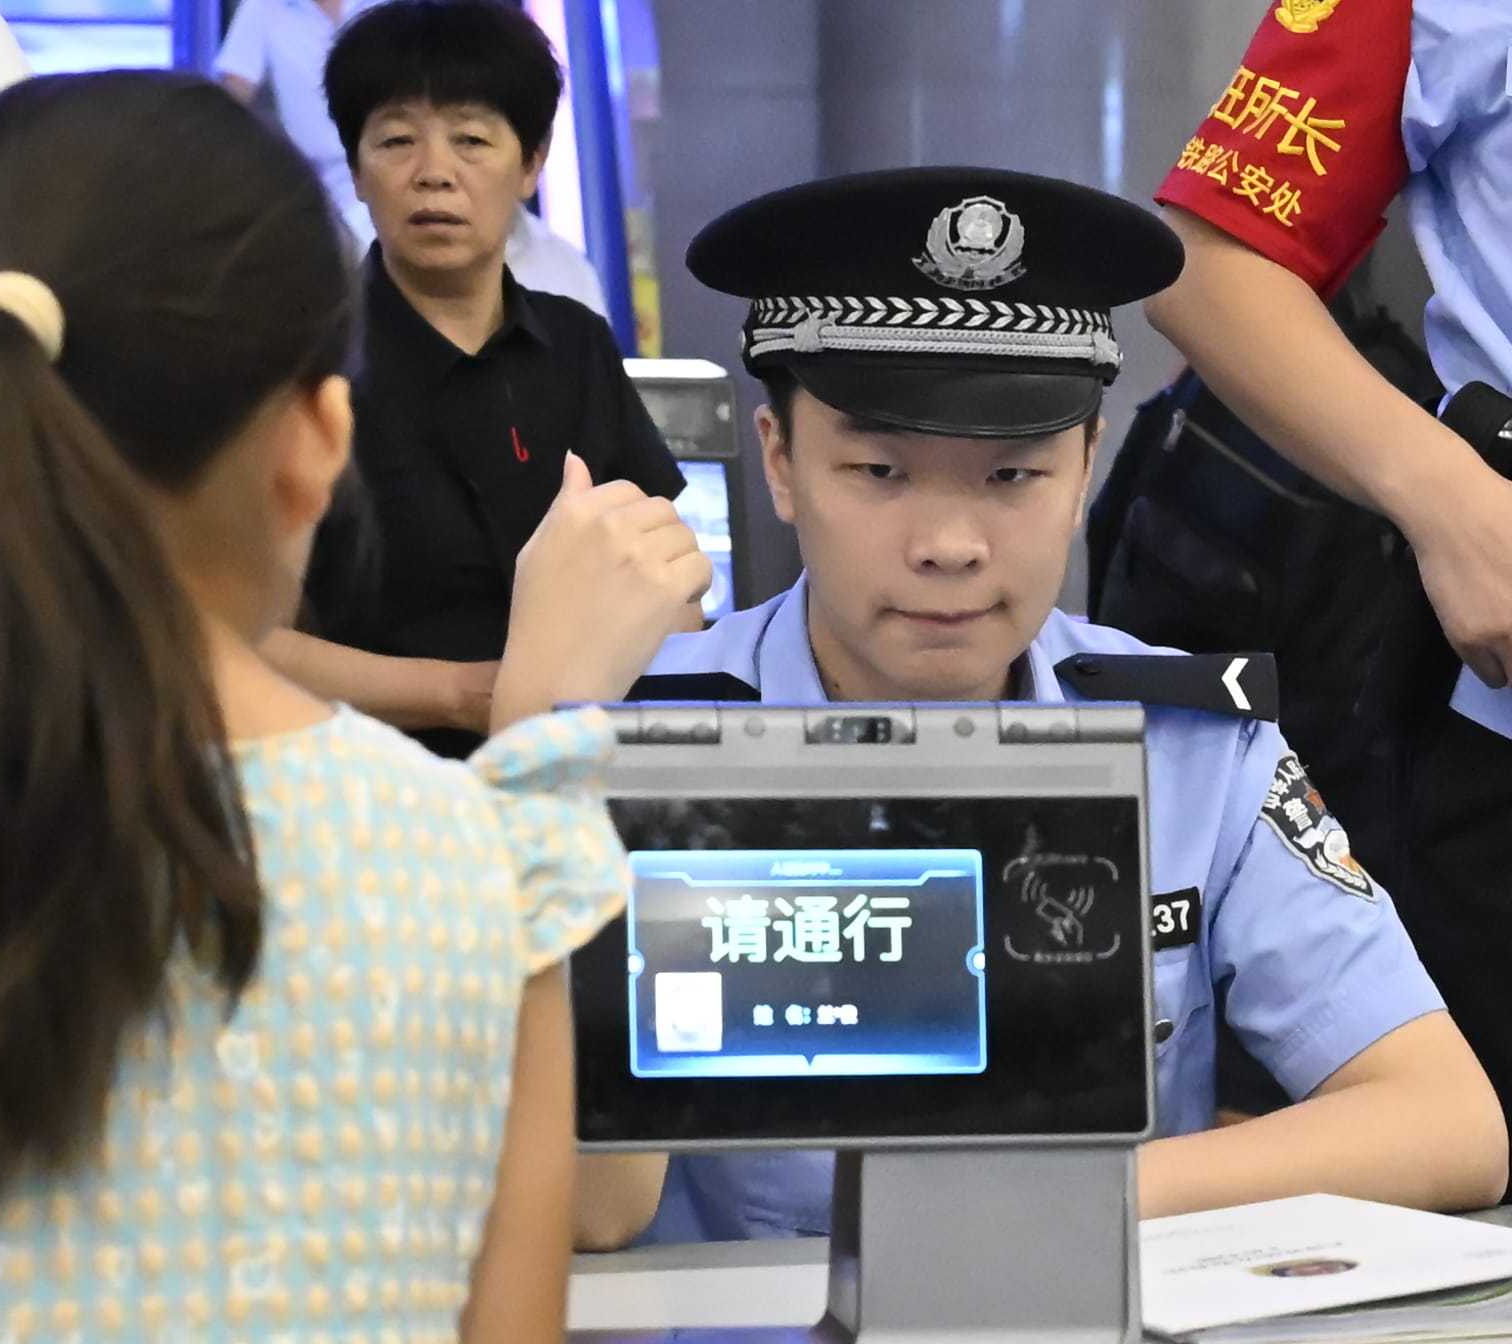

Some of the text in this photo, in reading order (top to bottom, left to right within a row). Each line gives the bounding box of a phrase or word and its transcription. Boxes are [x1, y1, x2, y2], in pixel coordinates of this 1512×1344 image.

[1176, 135, 1302, 227] 铁路公安处
[701, 893, 913, 964] 请通行
[1150, 899, 1191, 937] 37
